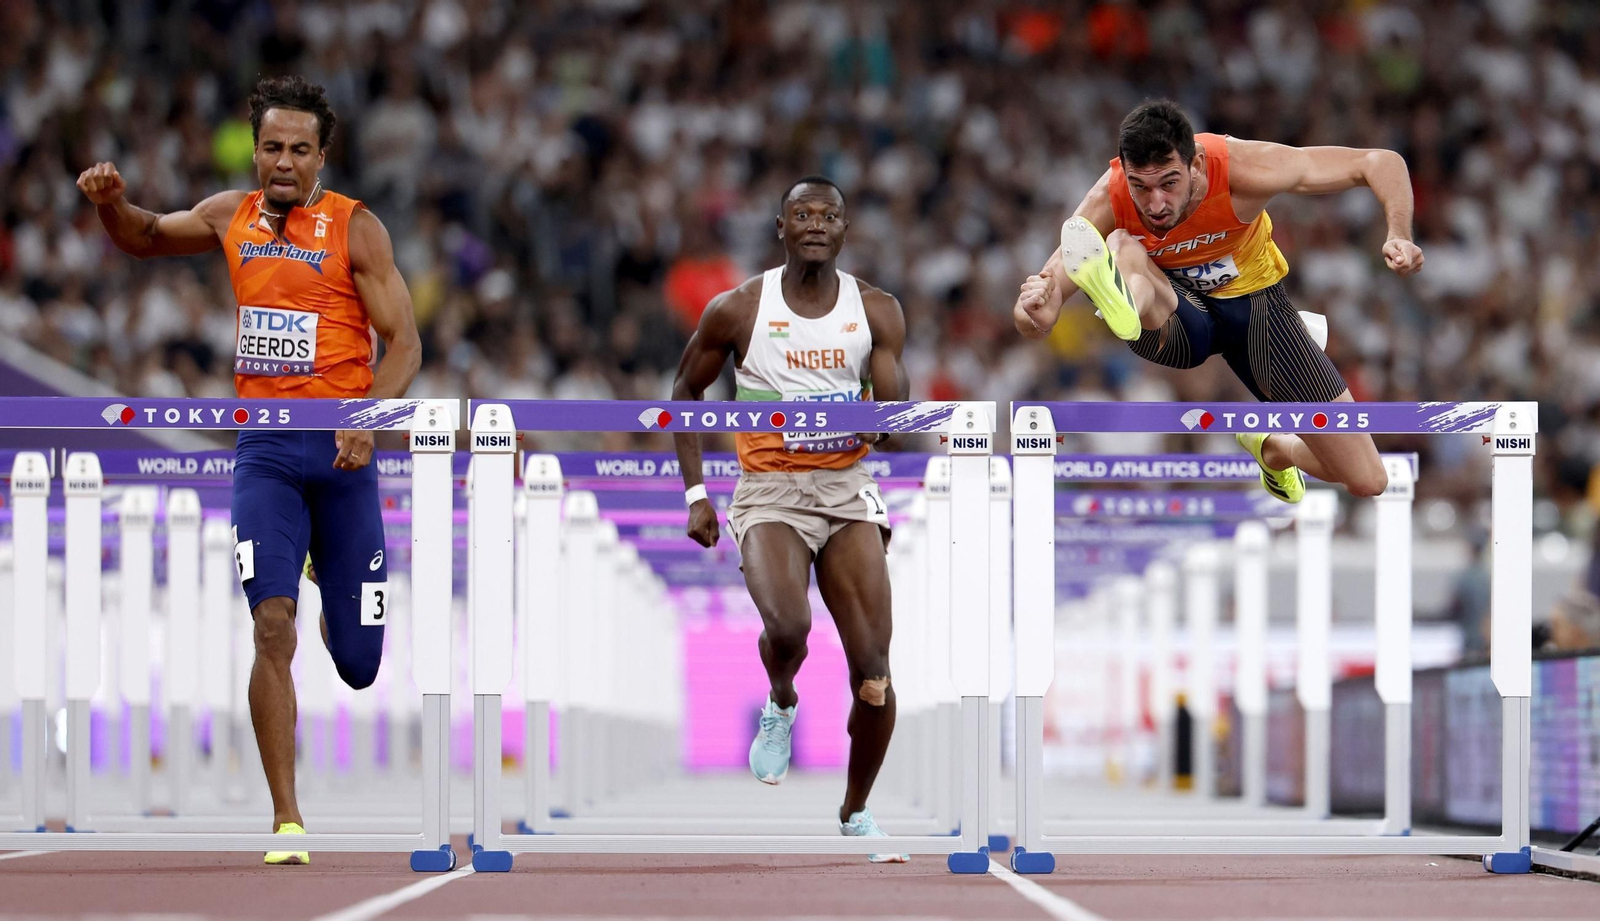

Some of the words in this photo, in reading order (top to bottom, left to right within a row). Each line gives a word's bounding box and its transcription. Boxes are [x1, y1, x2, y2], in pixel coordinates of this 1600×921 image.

[252, 311, 309, 333] TDK
[240, 335, 310, 358] GEERDS
[786, 348, 846, 369] NIGER
[144, 407, 250, 425] TOKYO
[257, 408, 291, 424] 25
[681, 411, 786, 428] TOKYO
[794, 412, 828, 427] 25
[1223, 412, 1329, 429] TOKYO
[1336, 413, 1370, 428] 25
[415, 435, 449, 446] NISHI
[476, 436, 511, 446] NISHI
[953, 438, 987, 448] NISHI
[1017, 438, 1051, 448] NISHI
[1496, 438, 1531, 449] NISHI
[138, 458, 198, 474] WORLD
[595, 460, 656, 476] WORLD
[660, 460, 743, 476] ATETIC
[1111, 461, 1201, 478] ATHLETICS
[373, 590, 384, 620] 3
